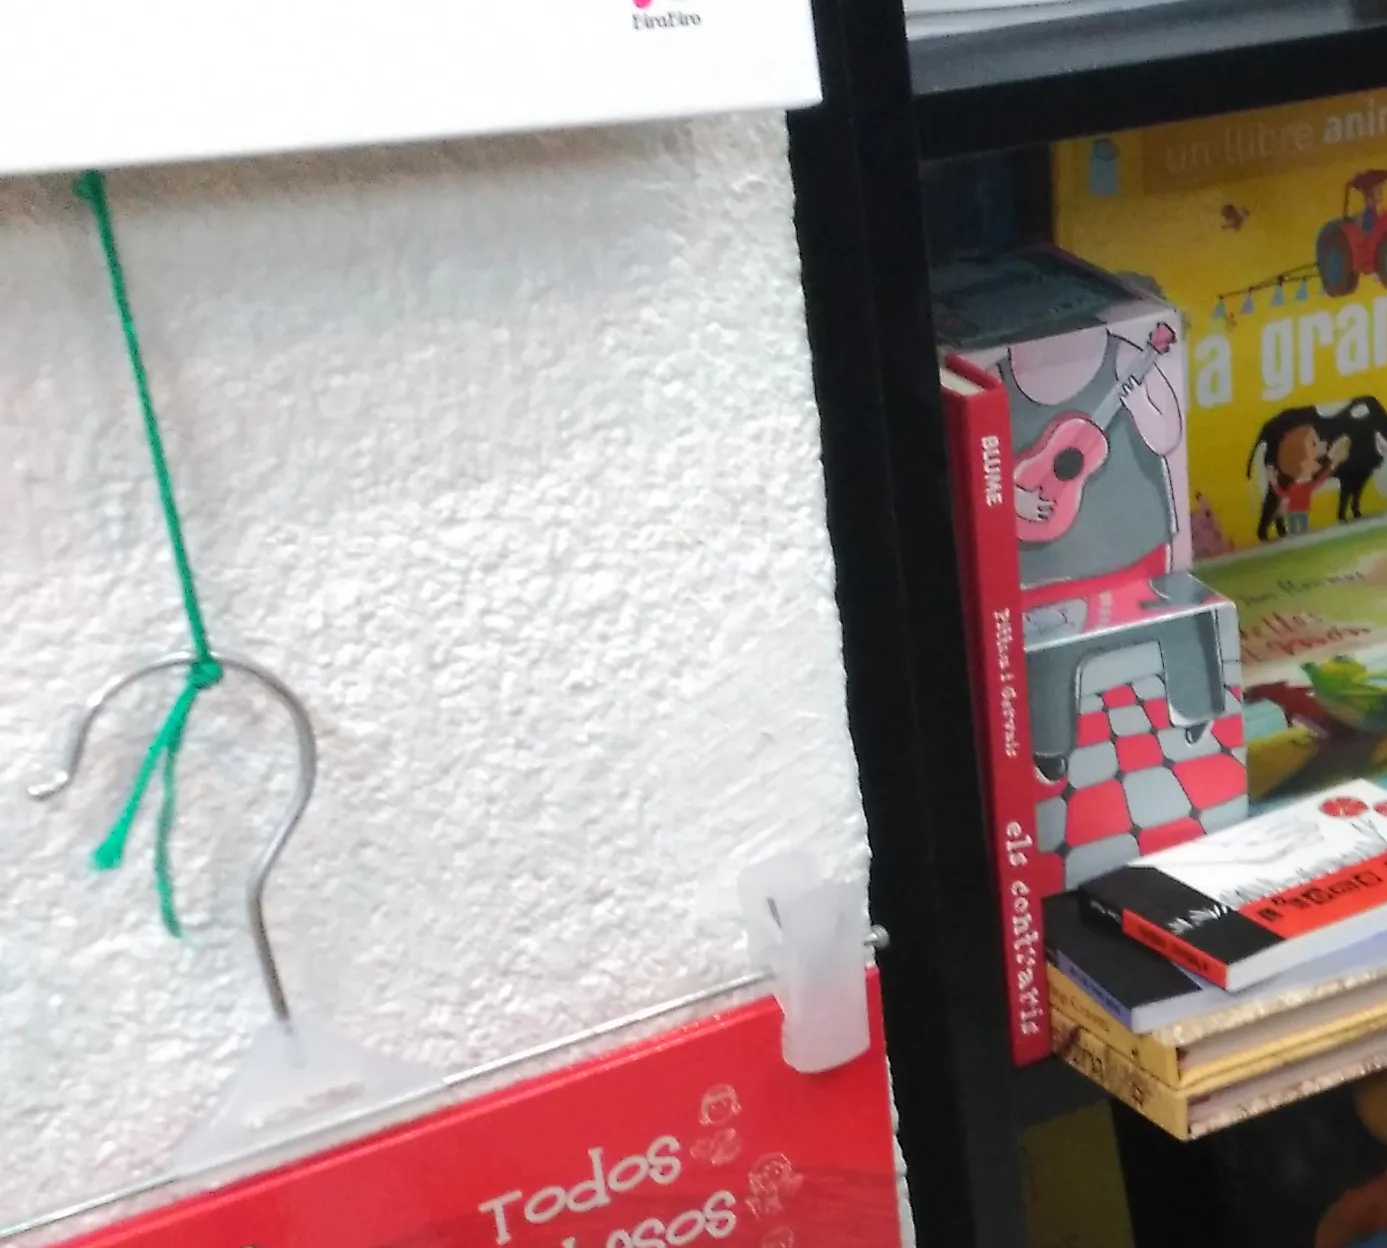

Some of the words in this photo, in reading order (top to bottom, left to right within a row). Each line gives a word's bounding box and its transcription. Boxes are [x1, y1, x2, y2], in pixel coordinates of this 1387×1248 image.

[1164, 130, 1212, 175] un
[1223, 112, 1317, 162] llibre
[980, 435, 1004, 508] BLUME
[1005, 820, 1034, 868] els
[1011, 879, 1040, 1036] contraris
[478, 1134, 682, 1246] Todos
